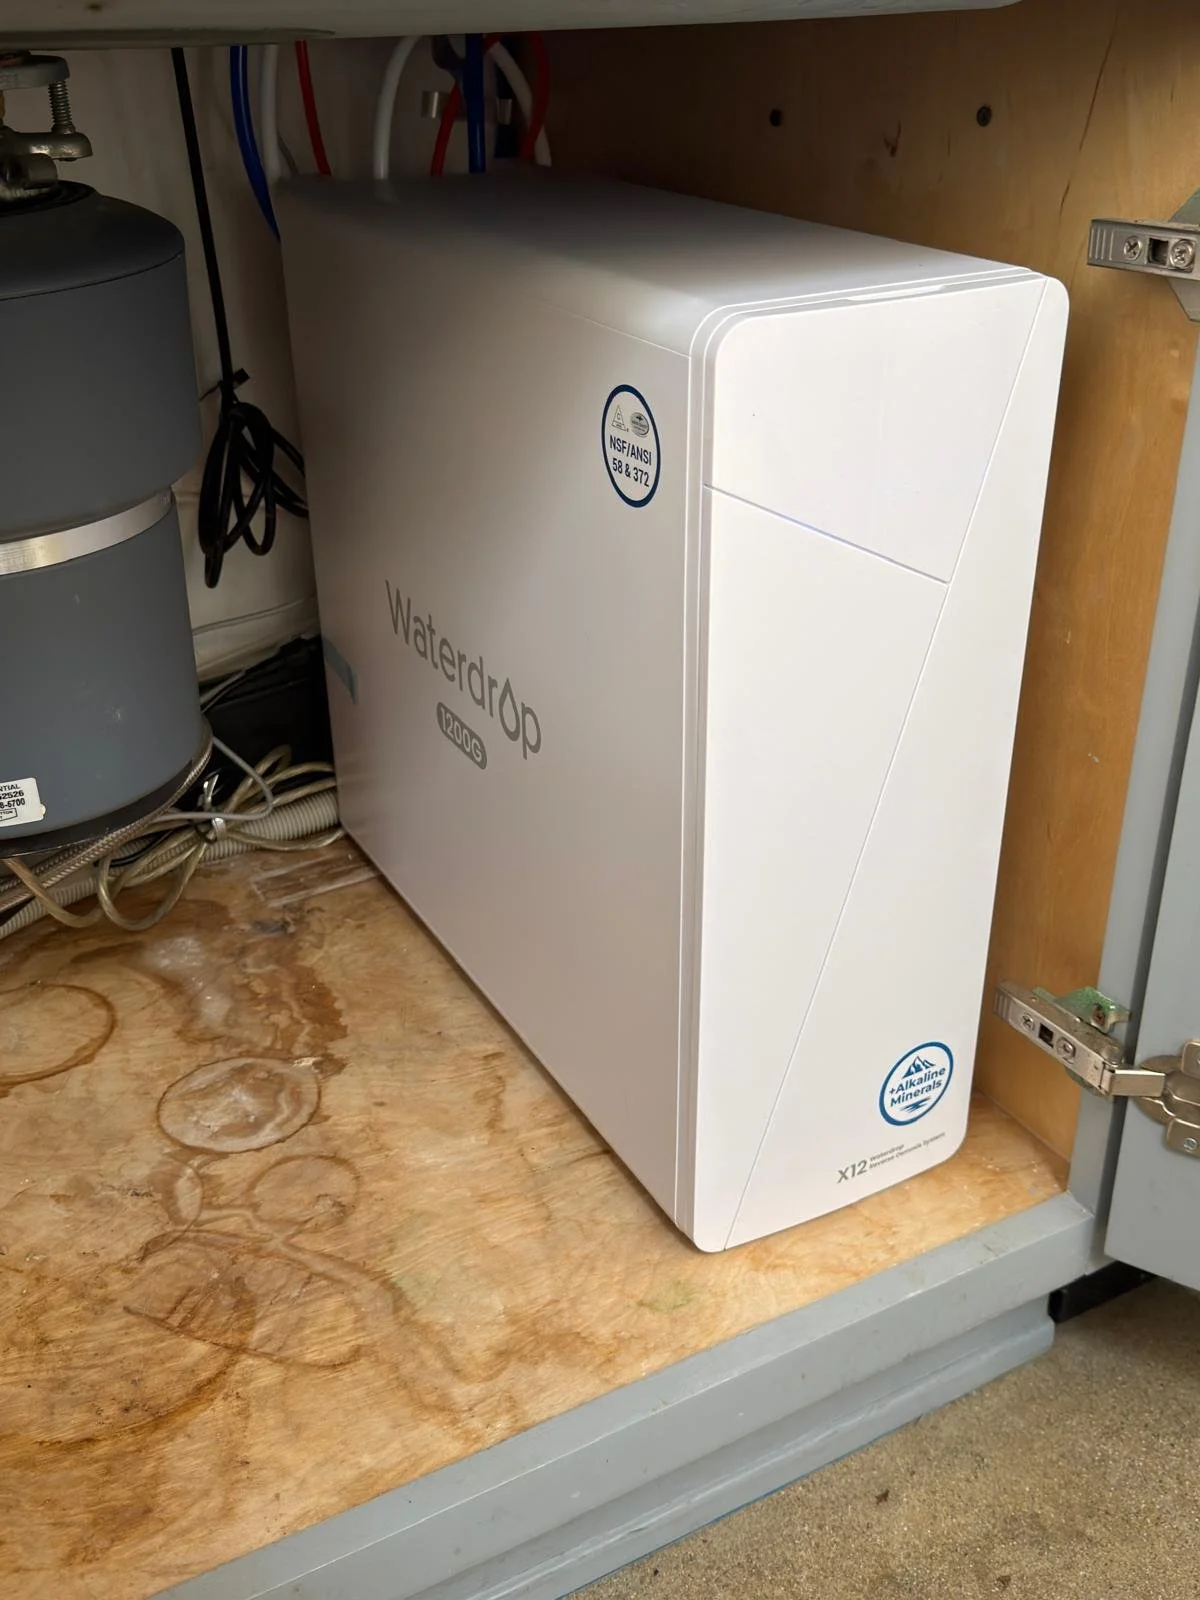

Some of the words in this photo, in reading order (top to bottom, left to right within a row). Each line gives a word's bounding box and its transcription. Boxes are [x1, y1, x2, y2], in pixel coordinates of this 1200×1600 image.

[610, 434, 652, 466] NSF/ANSI
[612, 458, 623, 474] 58
[624, 463, 631, 478] &
[633, 467, 650, 487] 372
[385, 579, 542, 760] Waterdrop
[440, 706, 483, 763] 1200G
[889, 1067, 946, 1096] +Alkaline
[890, 1079, 942, 1107] Minerals
[837, 1159, 868, 1184] X12
